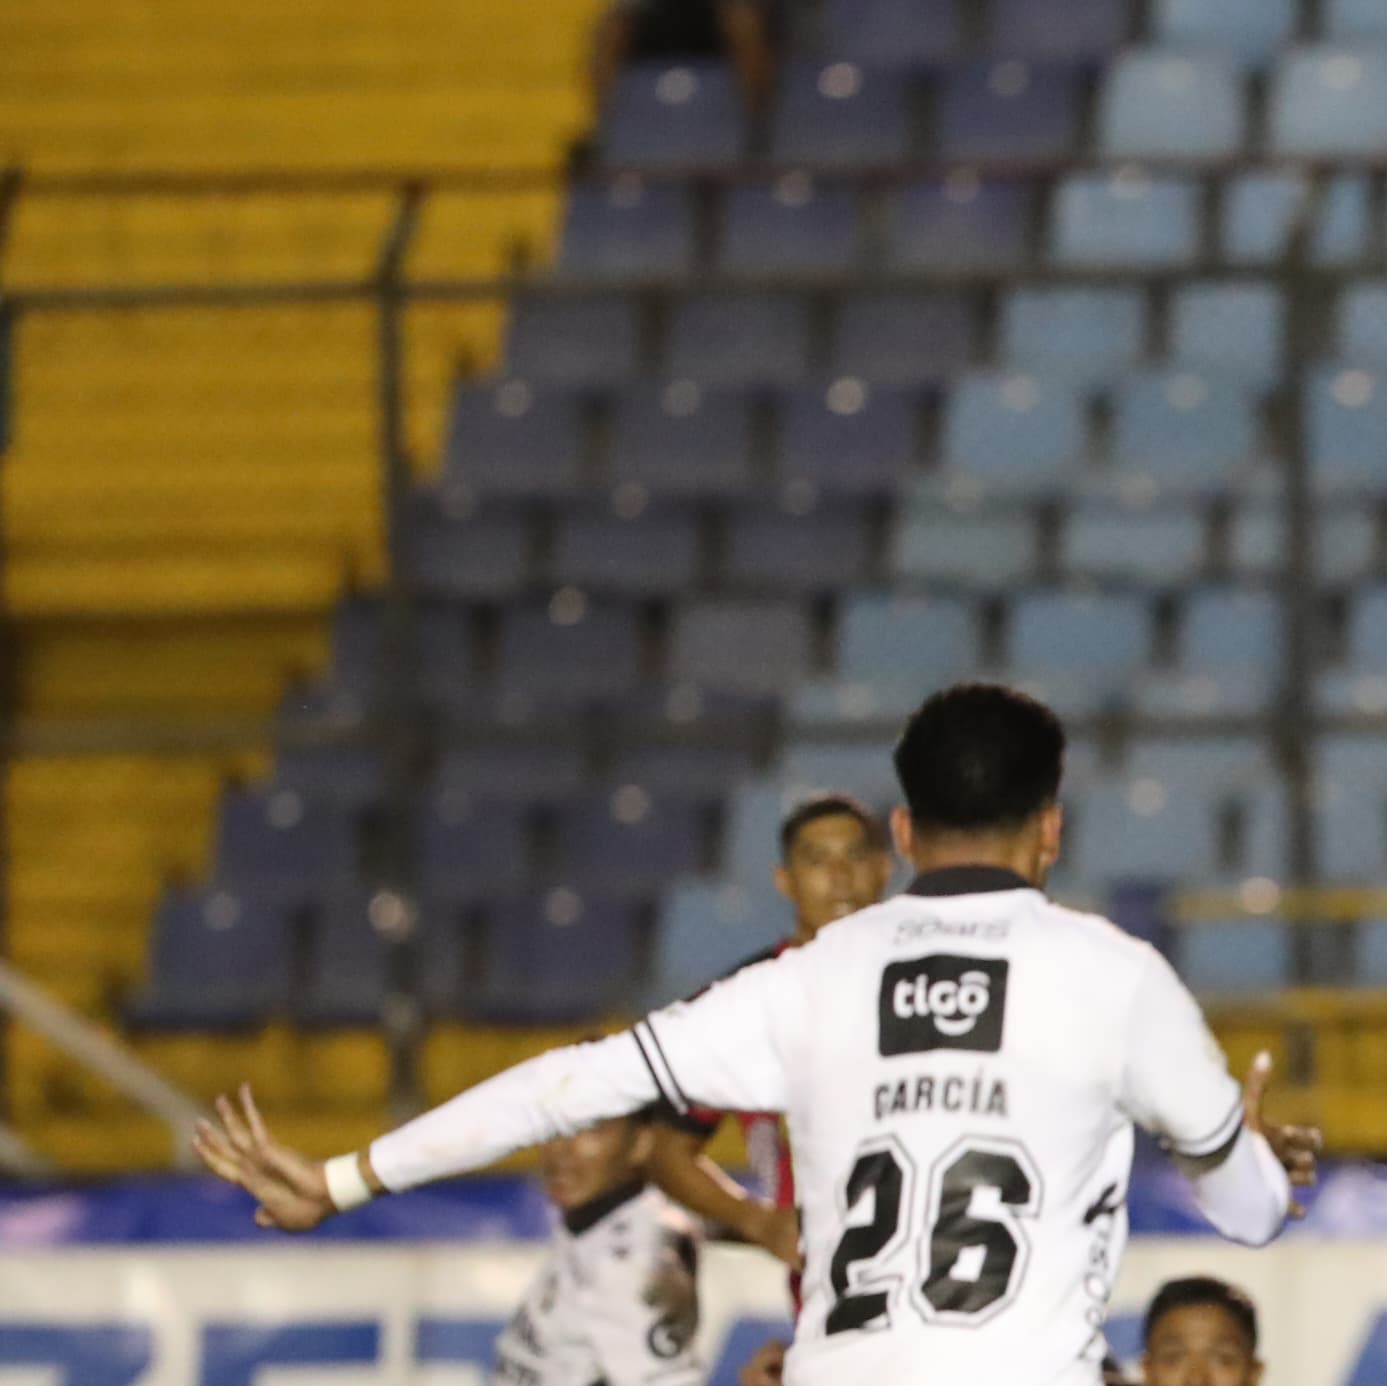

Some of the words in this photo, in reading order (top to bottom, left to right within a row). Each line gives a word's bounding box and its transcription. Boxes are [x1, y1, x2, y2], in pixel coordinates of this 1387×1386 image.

[893, 969, 991, 1036] tigo
[874, 1065, 1008, 1120] GARCÍA
[820, 1133, 1044, 1338] 26
